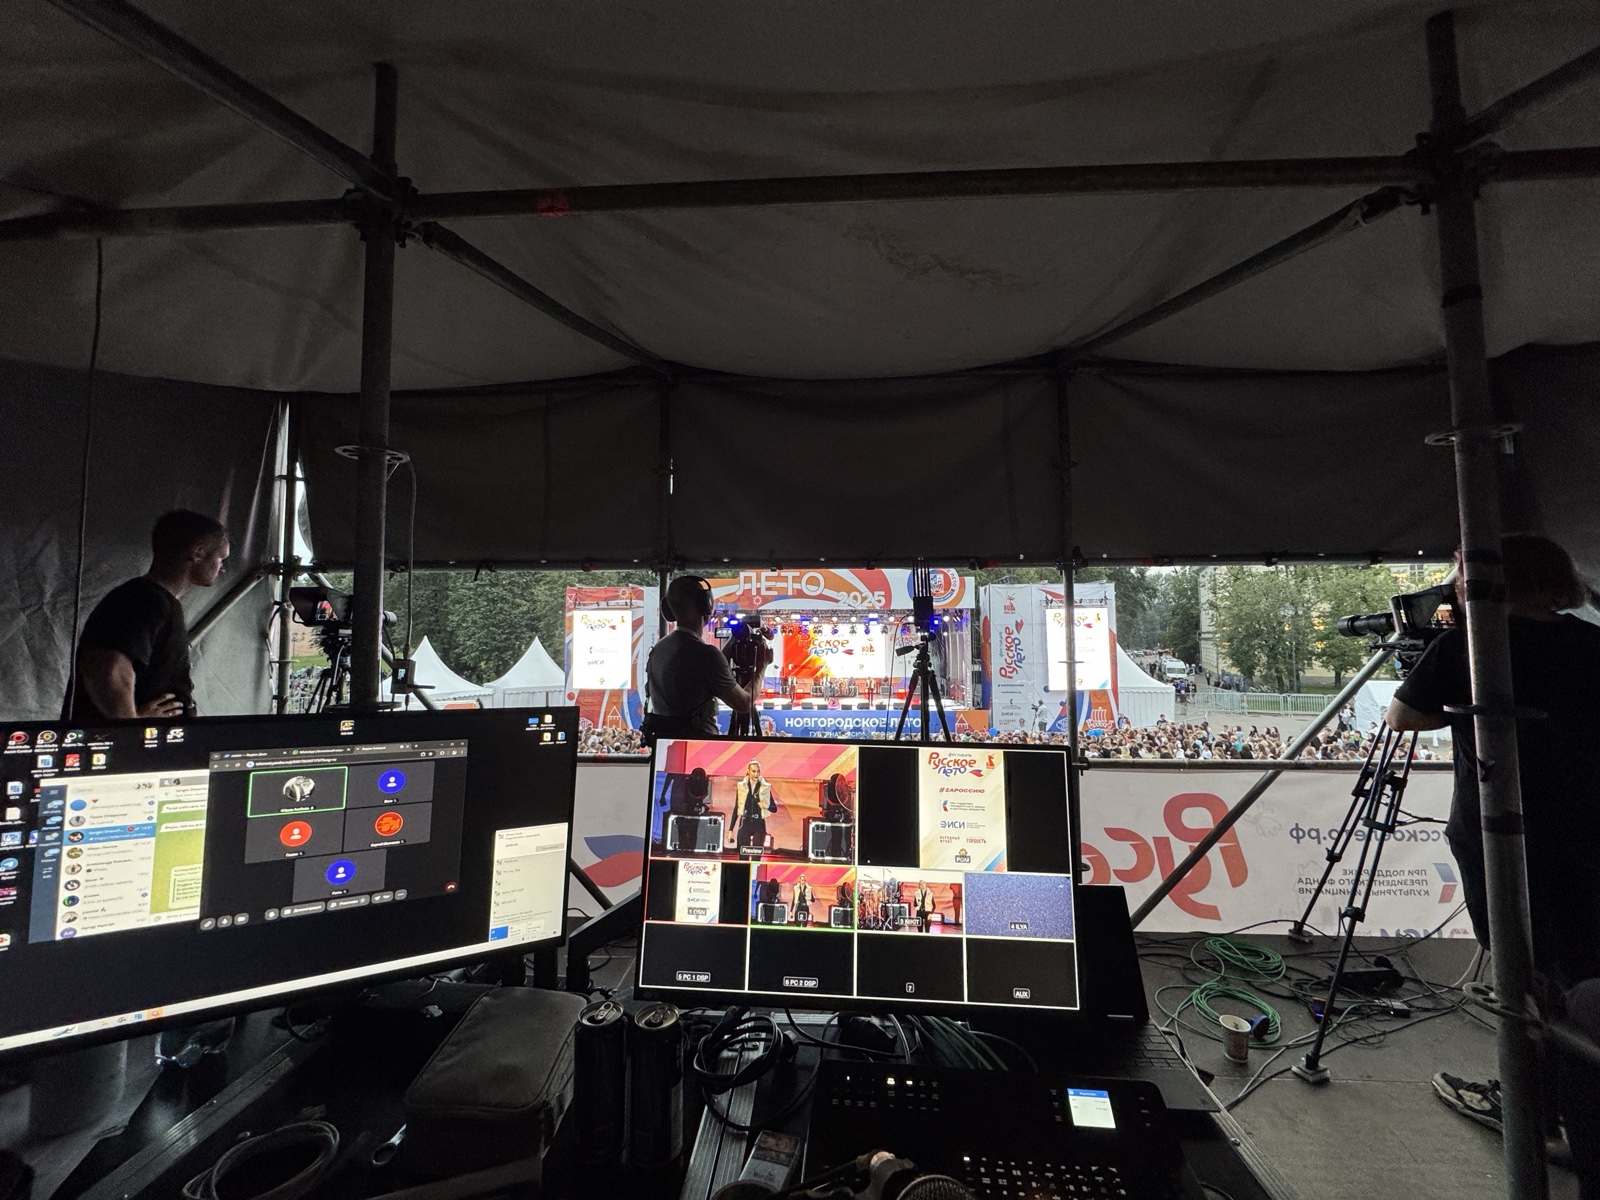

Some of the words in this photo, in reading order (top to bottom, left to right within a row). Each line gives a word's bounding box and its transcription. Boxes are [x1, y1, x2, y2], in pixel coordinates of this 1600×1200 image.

[735, 571, 825, 596] ЛЕТО
[837, 591, 886, 608] 2025
[785, 717, 886, 730] НОВГОРОДСКОЕ
[890, 717, 922, 729] ЛТО
[928, 752, 977, 770] Русское
